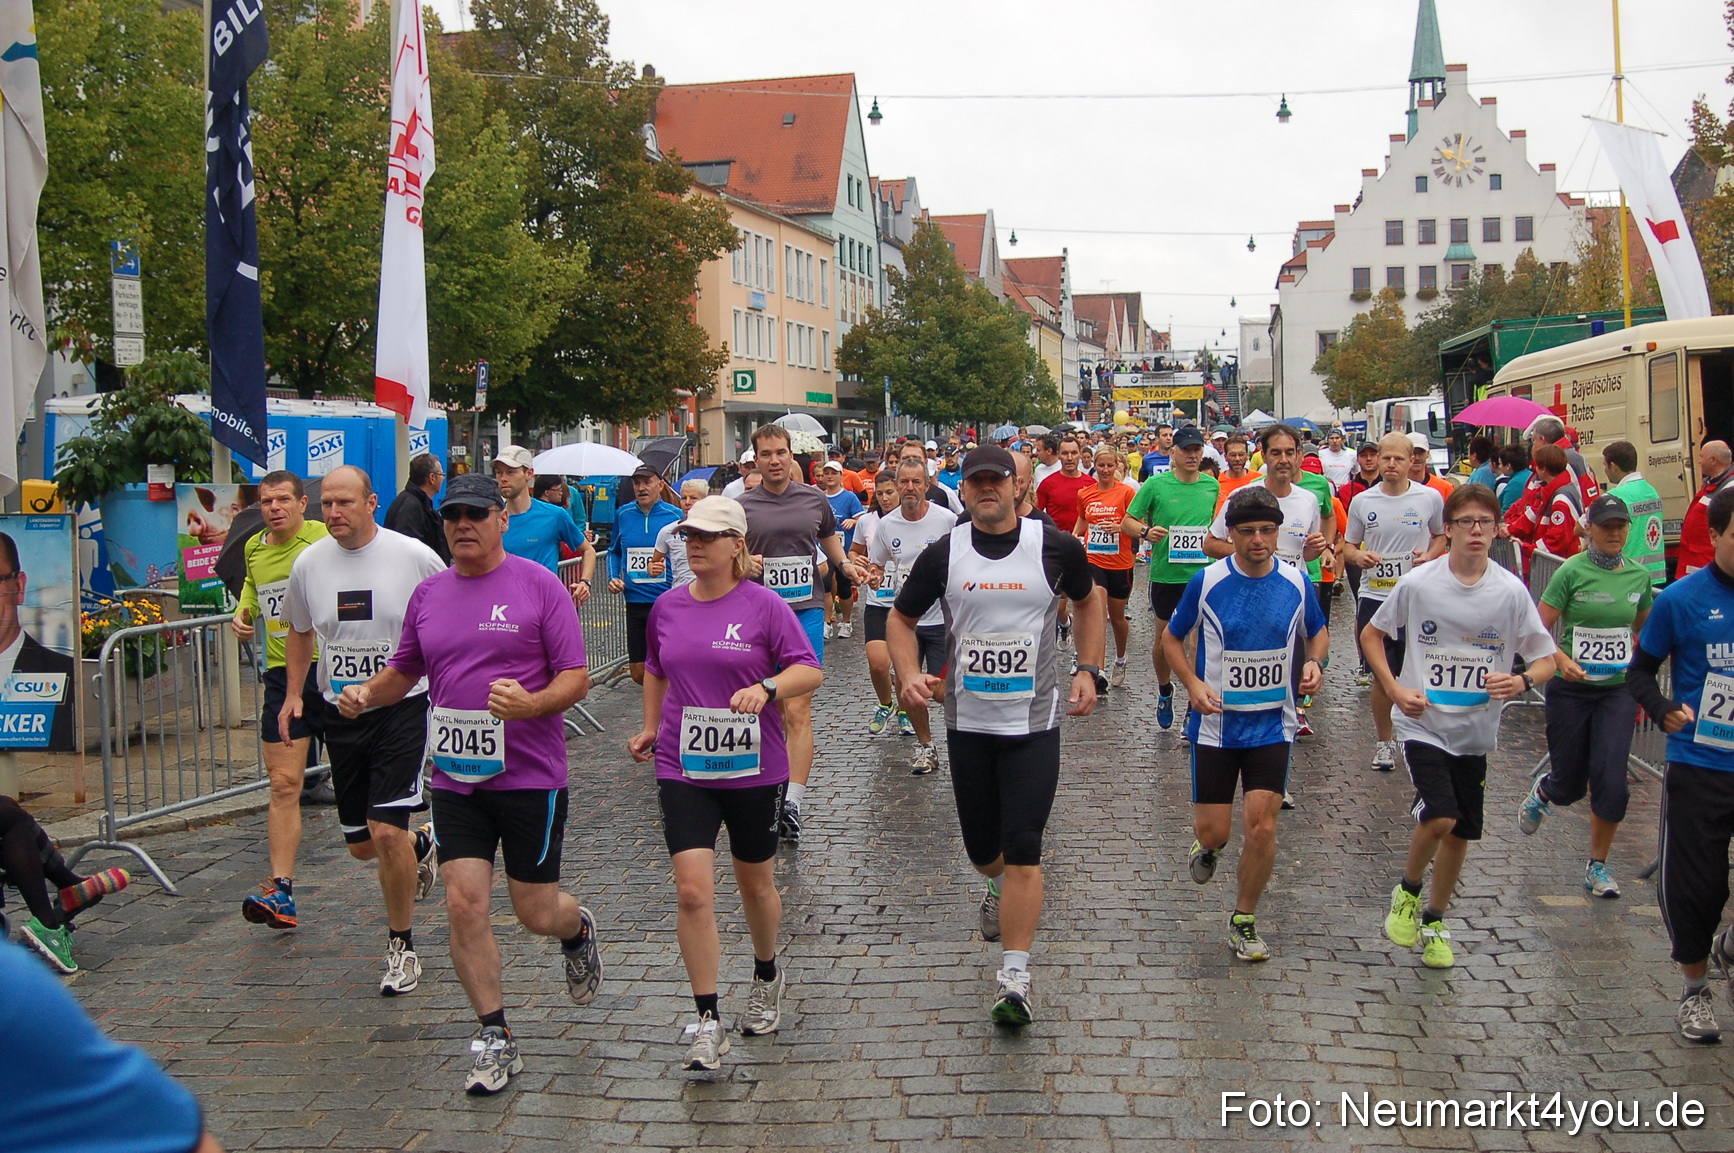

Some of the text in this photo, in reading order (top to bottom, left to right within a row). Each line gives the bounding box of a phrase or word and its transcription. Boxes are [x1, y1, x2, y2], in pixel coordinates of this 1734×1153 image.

[737, 373, 753, 390] D
[1571, 373, 1622, 401] Bayerisches
[1142, 390, 1173, 399] START
[1571, 403, 1595, 422] Rotes
[1648, 453, 1677, 467] Bayerisches
[187, 557, 209, 569] BEIDE
[769, 567, 809, 586] 3018
[979, 582, 1027, 591] KLEBL
[1574, 631, 1594, 639] PARTL
[327, 644, 379, 653] PARTL Neumarkt
[961, 639, 985, 647] PARTL
[1578, 640, 1626, 661] 2253
[968, 649, 1028, 674] 2692
[1224, 655, 1279, 664] PARTL Neumarkt
[1425, 653, 1484, 663] PARTL Neumarkt
[331, 654, 387, 678] 2546
[1588, 665, 1616, 674] Marion
[1229, 663, 1283, 688] 3080
[14, 681, 44, 693] CSU
[984, 680, 1010, 691] Peter
[1707, 679, 1733, 692] PARTL
[433, 714, 489, 726] PARTL Neumarkt
[684, 713, 746, 724] PARTL Neumarkt
[437, 726, 497, 756] 2045
[688, 725, 753, 752] 2044
[451, 761, 482, 773] Reiner
[704, 758, 734, 770] Sandi
